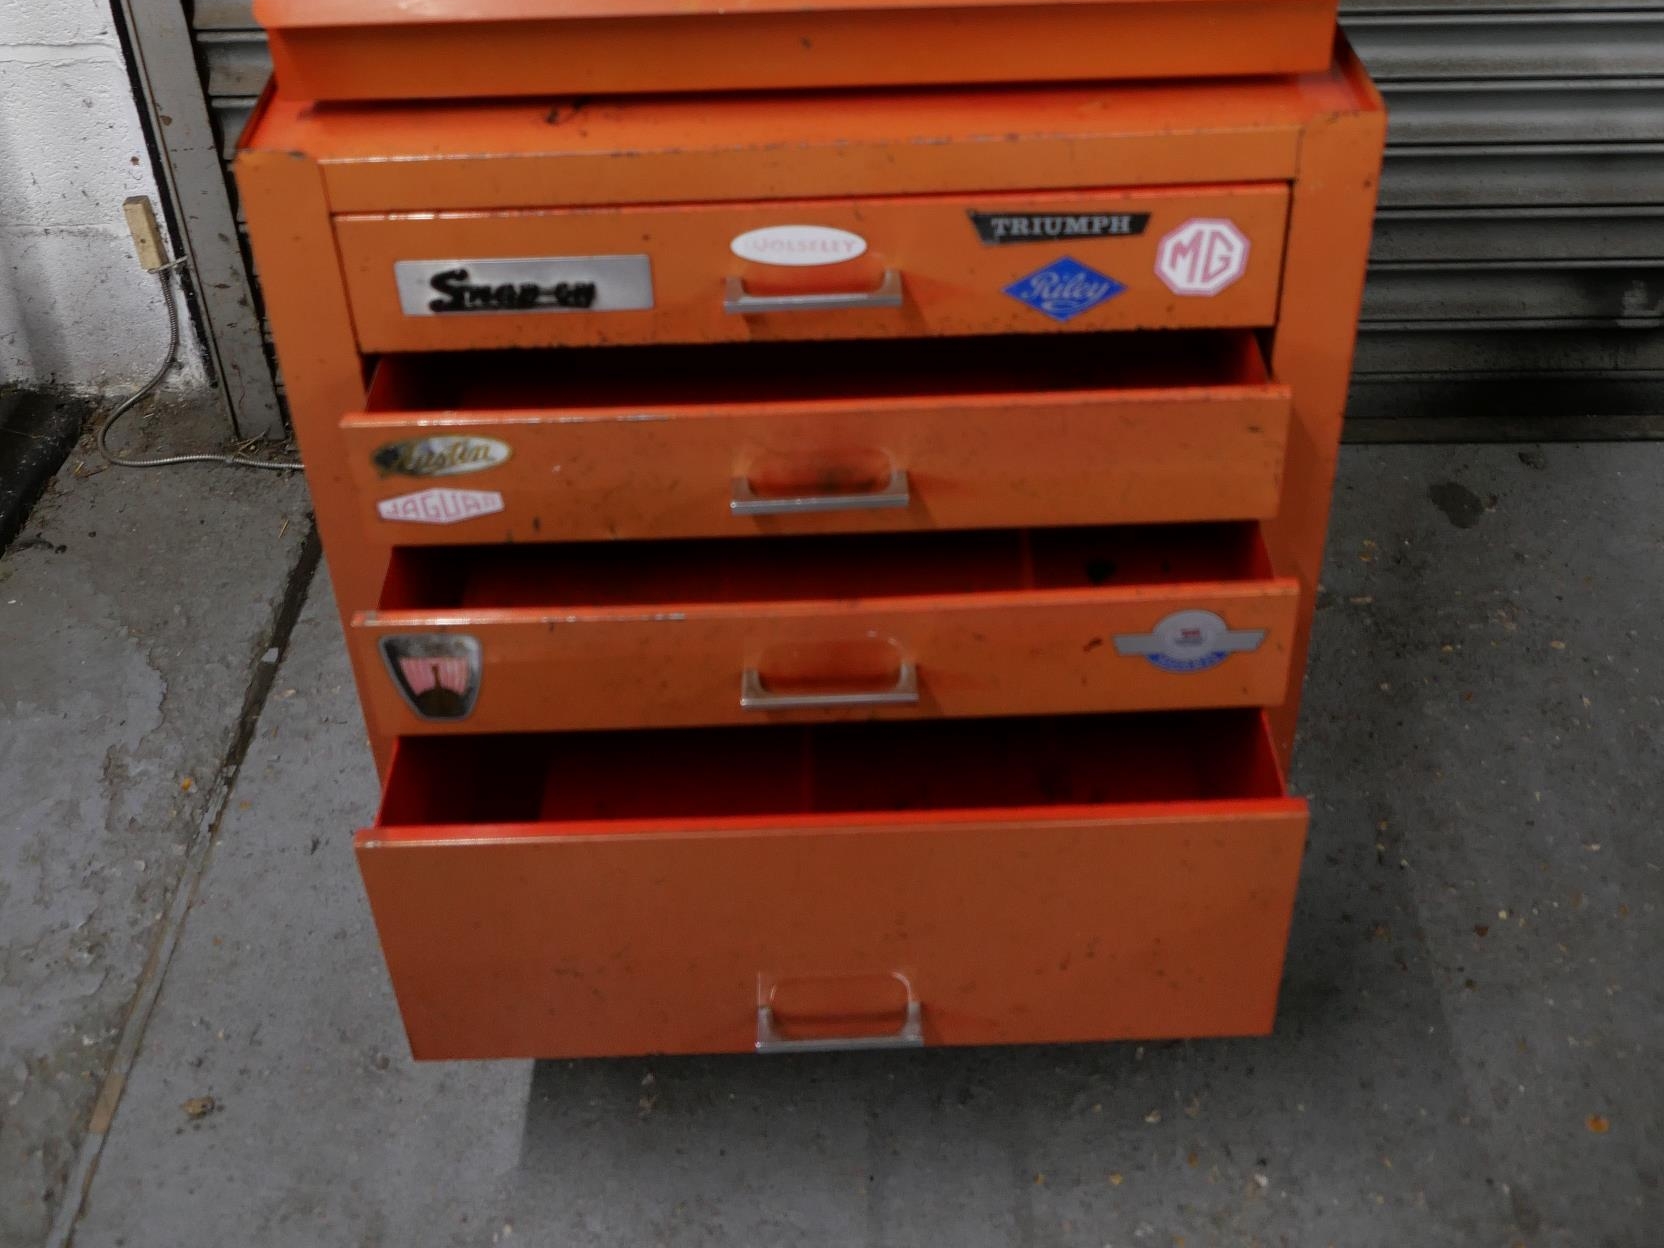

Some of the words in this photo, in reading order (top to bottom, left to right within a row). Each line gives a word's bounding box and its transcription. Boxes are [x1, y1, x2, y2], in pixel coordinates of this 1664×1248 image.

[990, 215, 1132, 237] TRIUMPH
[1170, 228, 1236, 284] MG
[428, 268, 597, 313] Snap-on
[1021, 269, 1111, 303] Riley
